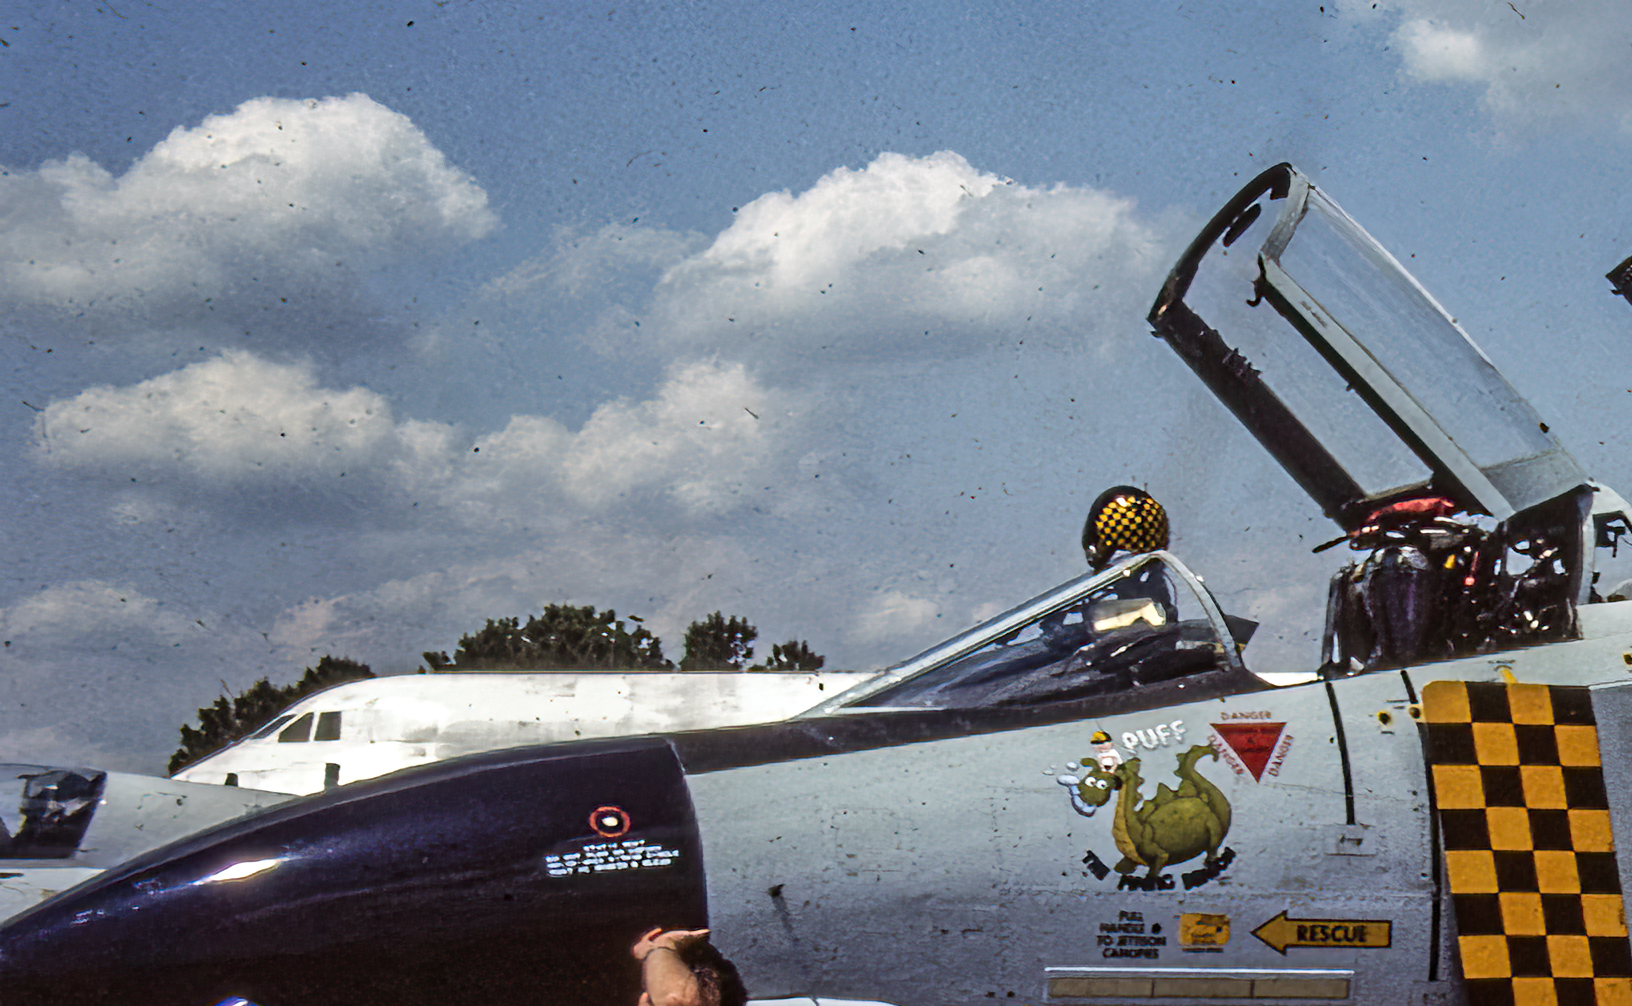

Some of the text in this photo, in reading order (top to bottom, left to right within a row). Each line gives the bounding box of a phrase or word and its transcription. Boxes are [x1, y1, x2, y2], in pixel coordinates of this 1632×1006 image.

[1220, 710, 1272, 721] DANGER
[1121, 719, 1187, 751] PUFF
[1296, 924, 1368, 943] RESCUE
